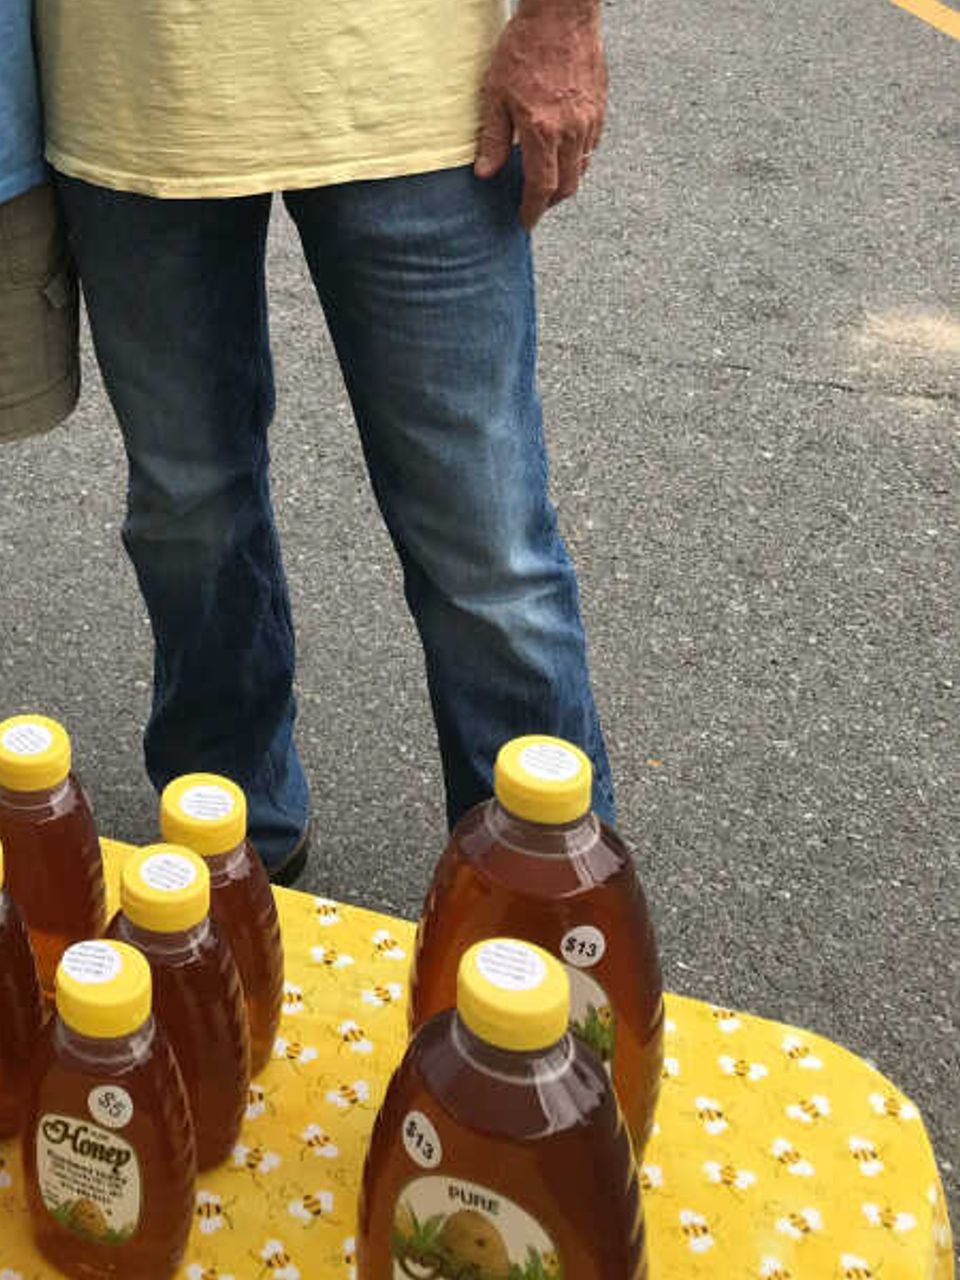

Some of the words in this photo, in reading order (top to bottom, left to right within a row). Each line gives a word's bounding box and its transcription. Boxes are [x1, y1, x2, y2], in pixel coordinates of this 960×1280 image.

[565, 936, 597, 957] $13
[43, 1119, 131, 1173] Honey
[406, 1120, 435, 1160] $13
[448, 1185, 500, 1216] PURE
